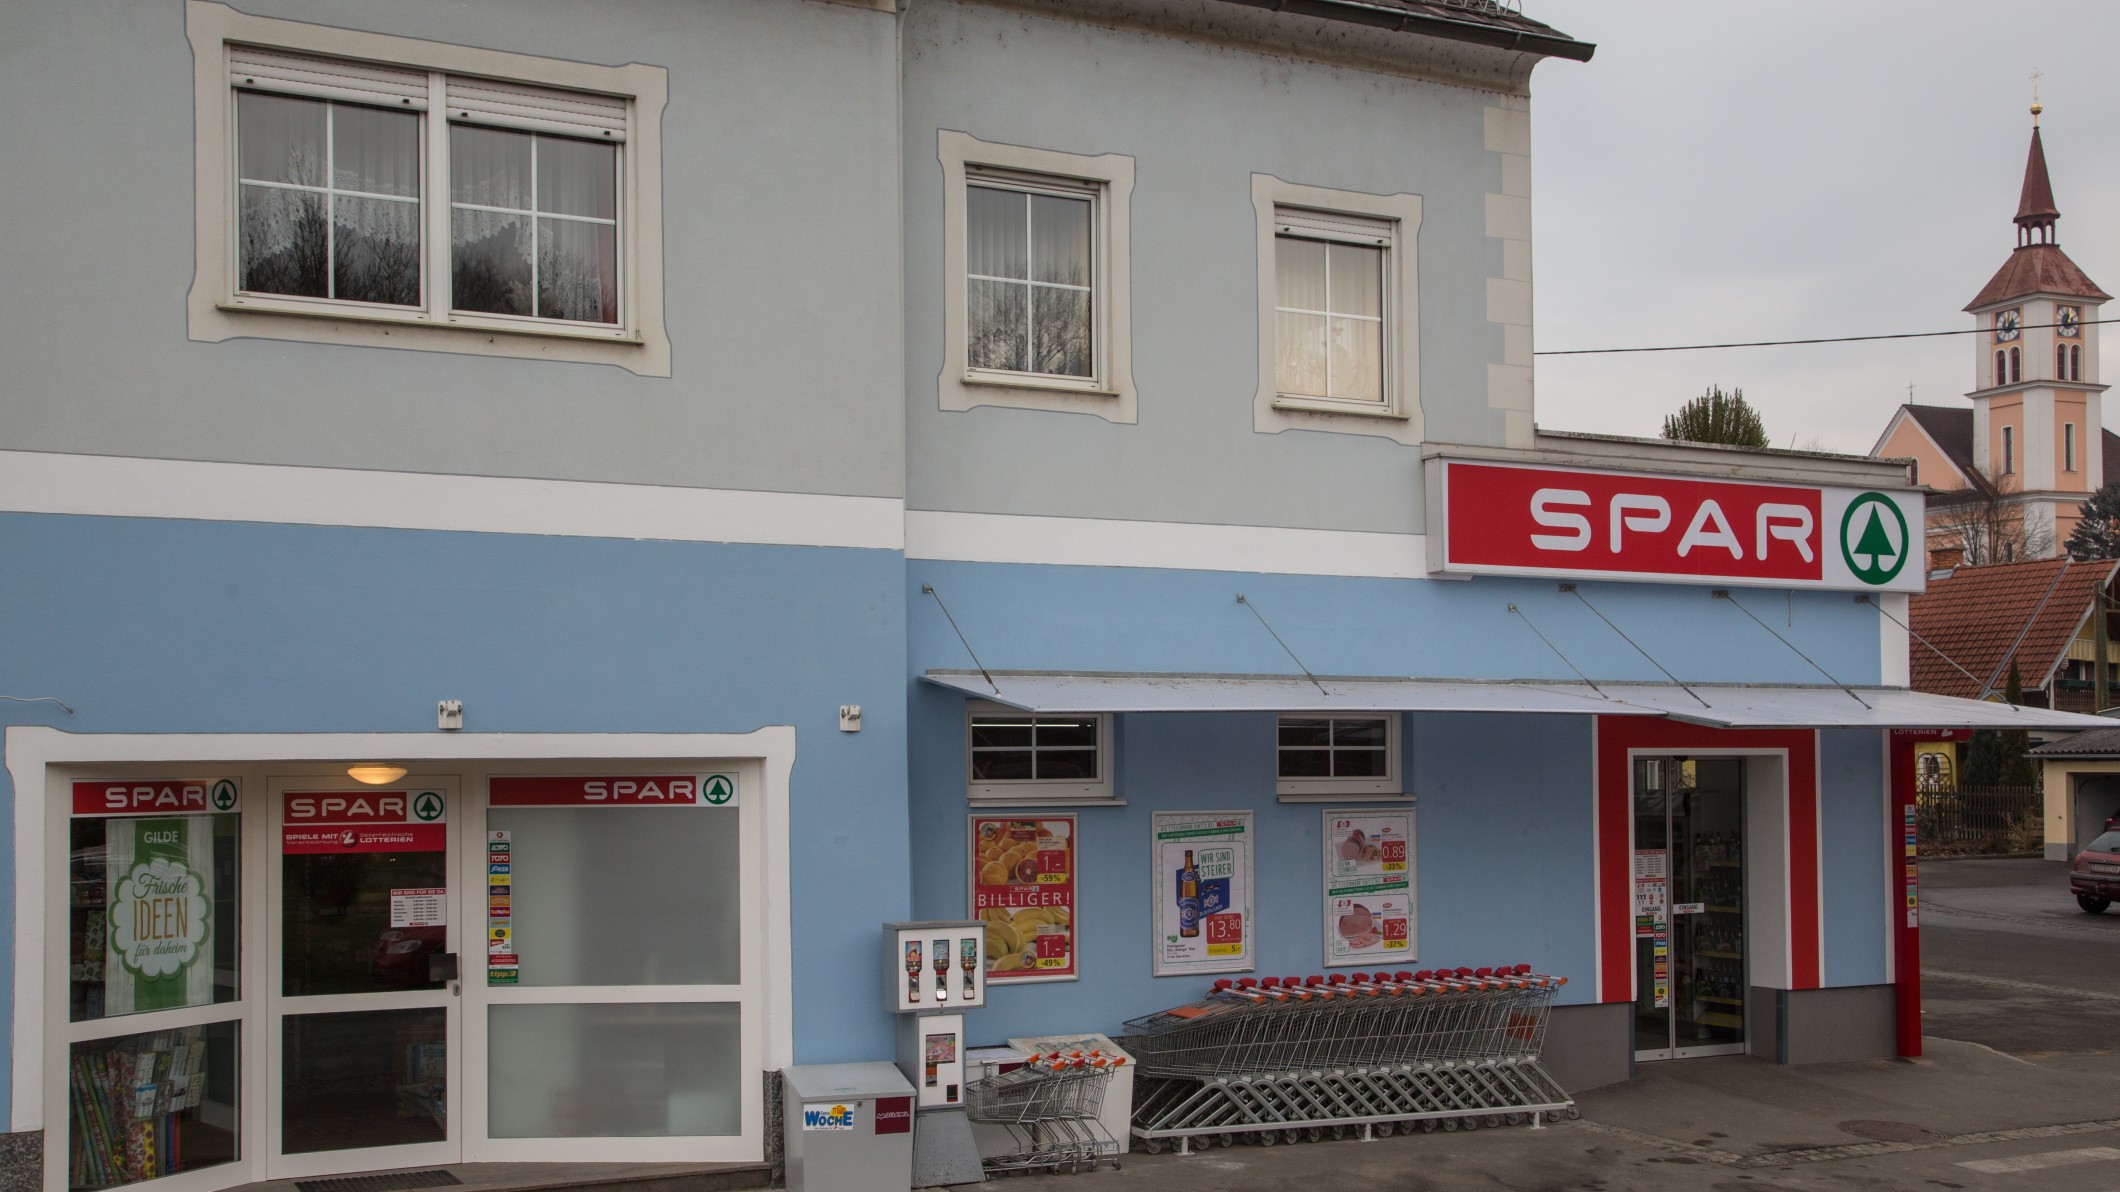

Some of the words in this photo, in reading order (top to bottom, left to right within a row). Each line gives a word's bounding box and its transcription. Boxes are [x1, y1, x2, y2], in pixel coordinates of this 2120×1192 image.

[1530, 487, 1814, 563] SPAR
[105, 785, 204, 808] SPAR
[583, 780, 693, 800] SPAR
[290, 797, 404, 818] SPAR
[144, 830, 178, 844] GILDE
[1200, 853, 1214, 864] WIR
[1215, 851, 1231, 862] SIND
[1382, 845, 1405, 859] 0.89
[1201, 862, 1232, 877] STEIRER
[132, 872, 189, 899] Frische
[978, 892, 1070, 907] BILLIGER!
[133, 896, 188, 942] IDEEN
[1383, 922, 1407, 937] 1.29
[1386, 940, 1403, 948] -37%
[133, 942, 150, 964] für
[153, 940, 188, 955] daheim
[1041, 959, 1061, 967] -49%
